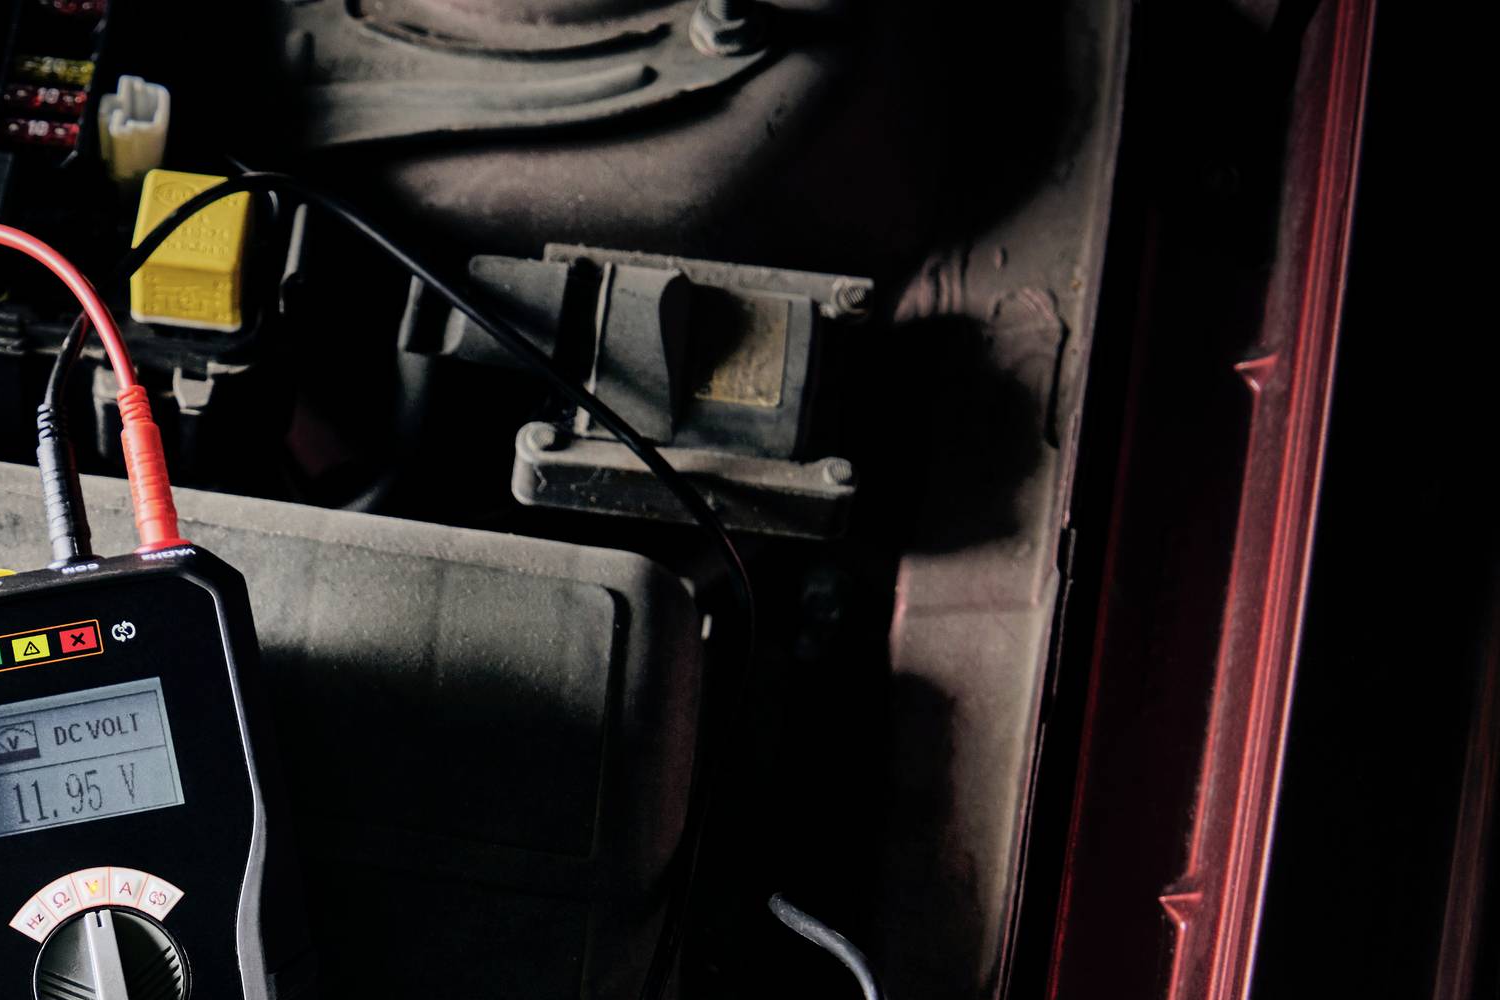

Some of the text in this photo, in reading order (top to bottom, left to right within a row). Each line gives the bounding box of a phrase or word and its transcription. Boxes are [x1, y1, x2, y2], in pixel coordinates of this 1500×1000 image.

[37, 87, 60, 104] 10
[28, 120, 49, 137] 10
[61, 562, 99, 575] COM
[85, 712, 140, 740] VOLT
[12, 762, 135, 824] 11.95 V
[118, 881, 133, 896] A
[27, 913, 45, 930] Hz
